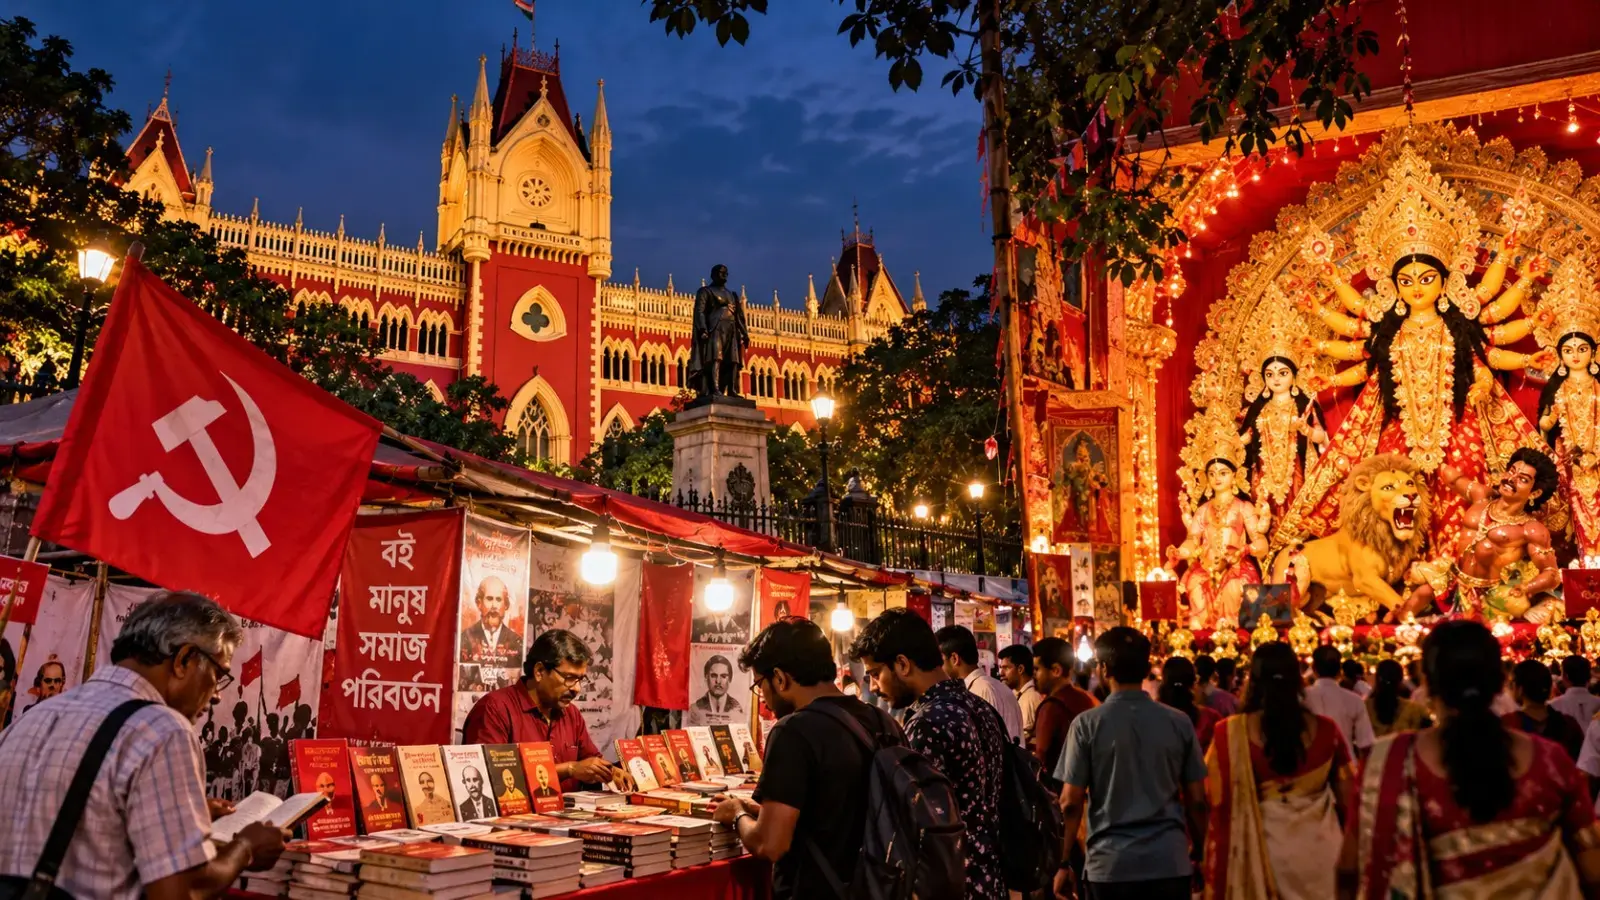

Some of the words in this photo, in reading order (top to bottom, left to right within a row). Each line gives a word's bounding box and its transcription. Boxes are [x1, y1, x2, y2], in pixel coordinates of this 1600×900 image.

[381, 529, 416, 571] বই
[359, 631, 430, 664] সমাজ
[341, 668, 443, 714] পরিবর্তন
